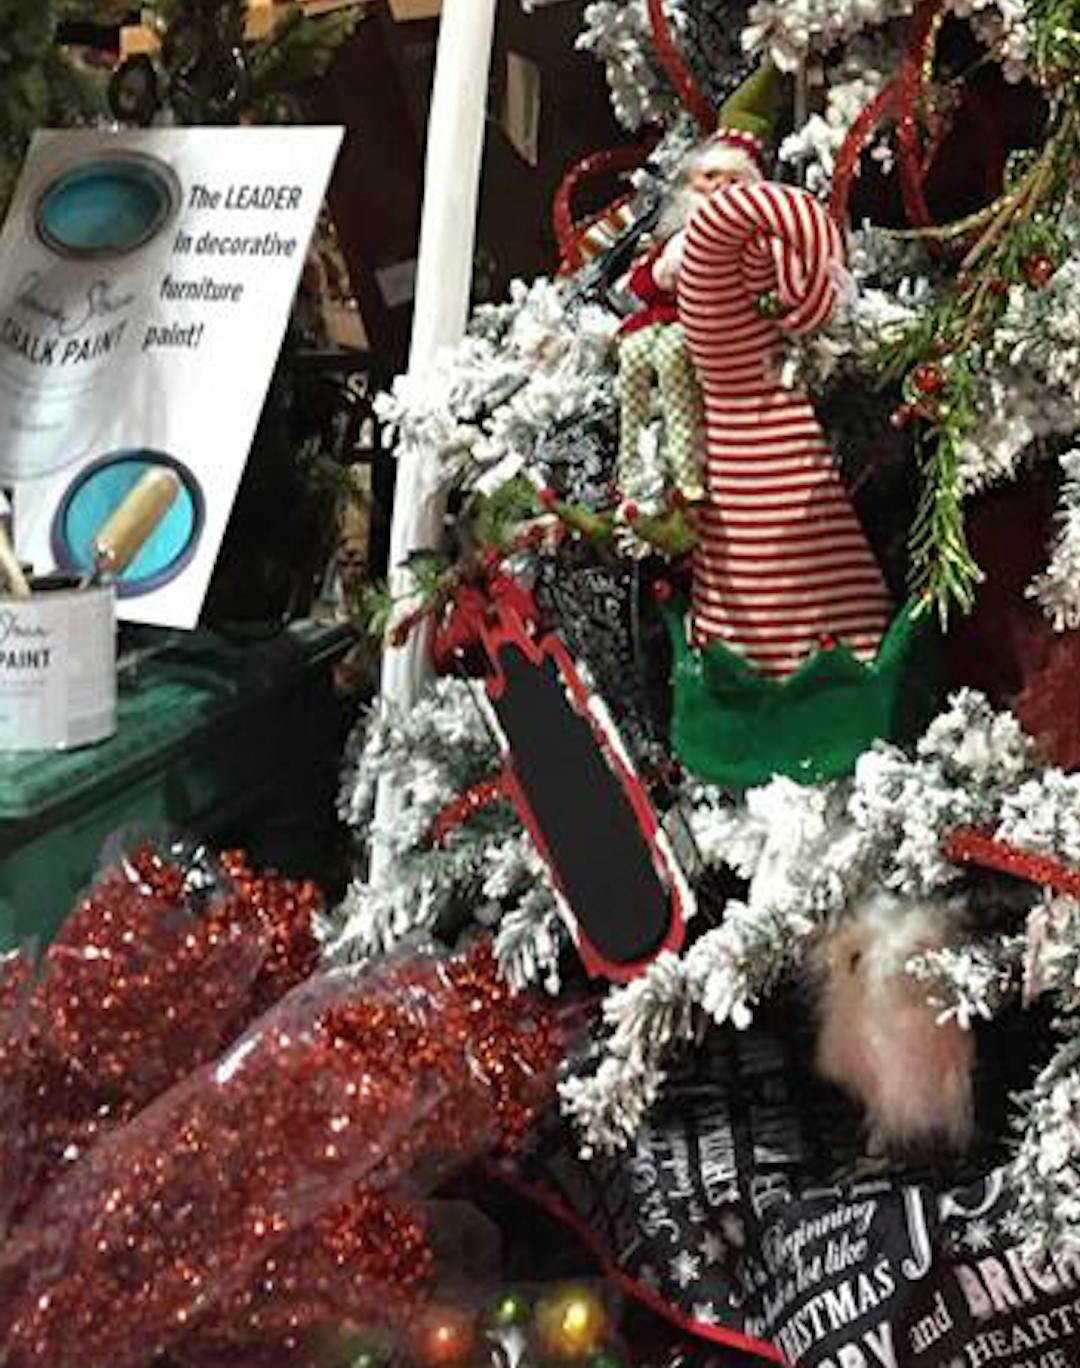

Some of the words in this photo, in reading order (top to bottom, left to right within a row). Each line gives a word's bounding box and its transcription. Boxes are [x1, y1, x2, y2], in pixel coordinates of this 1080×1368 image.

[188, 184, 222, 210] The
[225, 185, 303, 211] LEADER
[195, 232, 297, 257] decorative
[159, 274, 244, 302] furniture
[61, 318, 129, 366] PAINT
[142, 324, 205, 353] paint!
[907, 1290, 954, 1355] and
